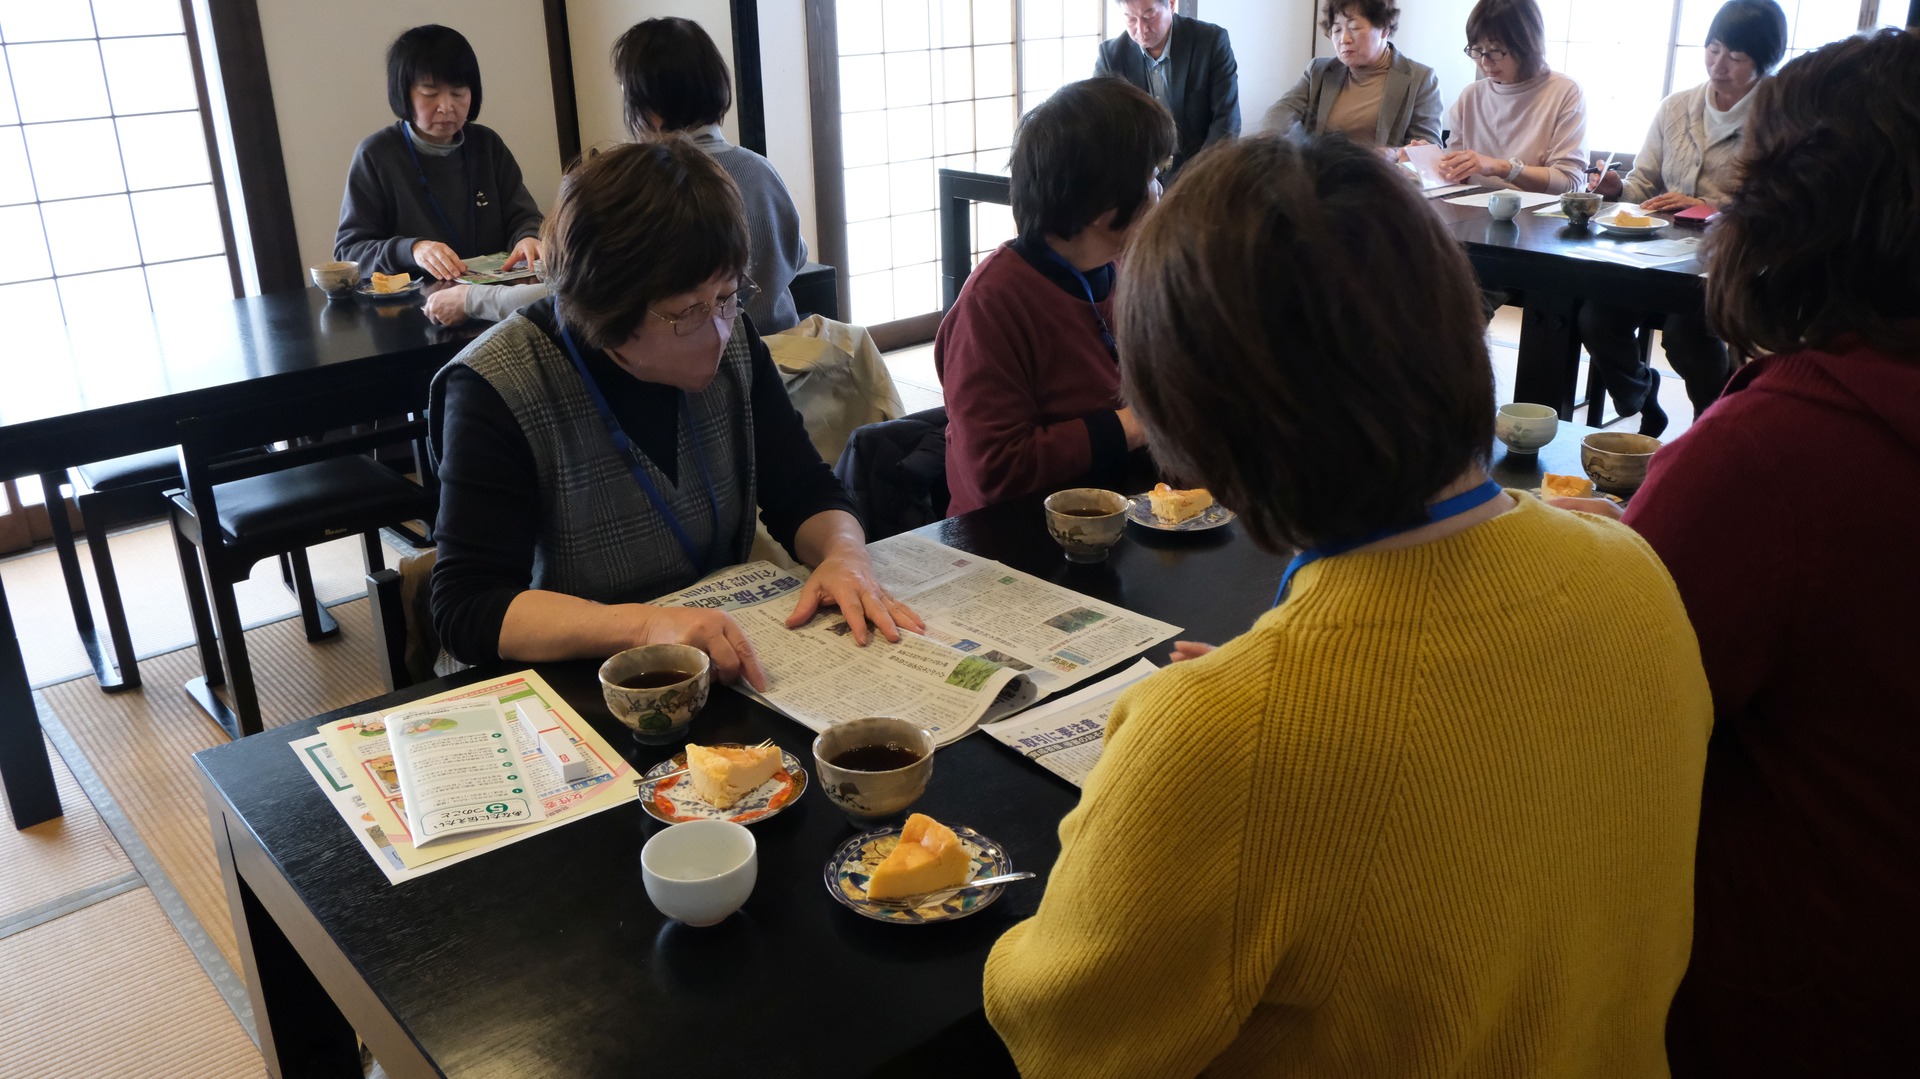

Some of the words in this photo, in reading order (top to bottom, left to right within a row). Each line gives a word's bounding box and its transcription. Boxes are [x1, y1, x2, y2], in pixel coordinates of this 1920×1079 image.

[680, 569, 777, 599] 全国農業新聞
[683, 576, 801, 609] 電子版を配信
[433, 809, 523, 829] あなたに伝えたい
[546, 805, 569, 818] 宮城県
